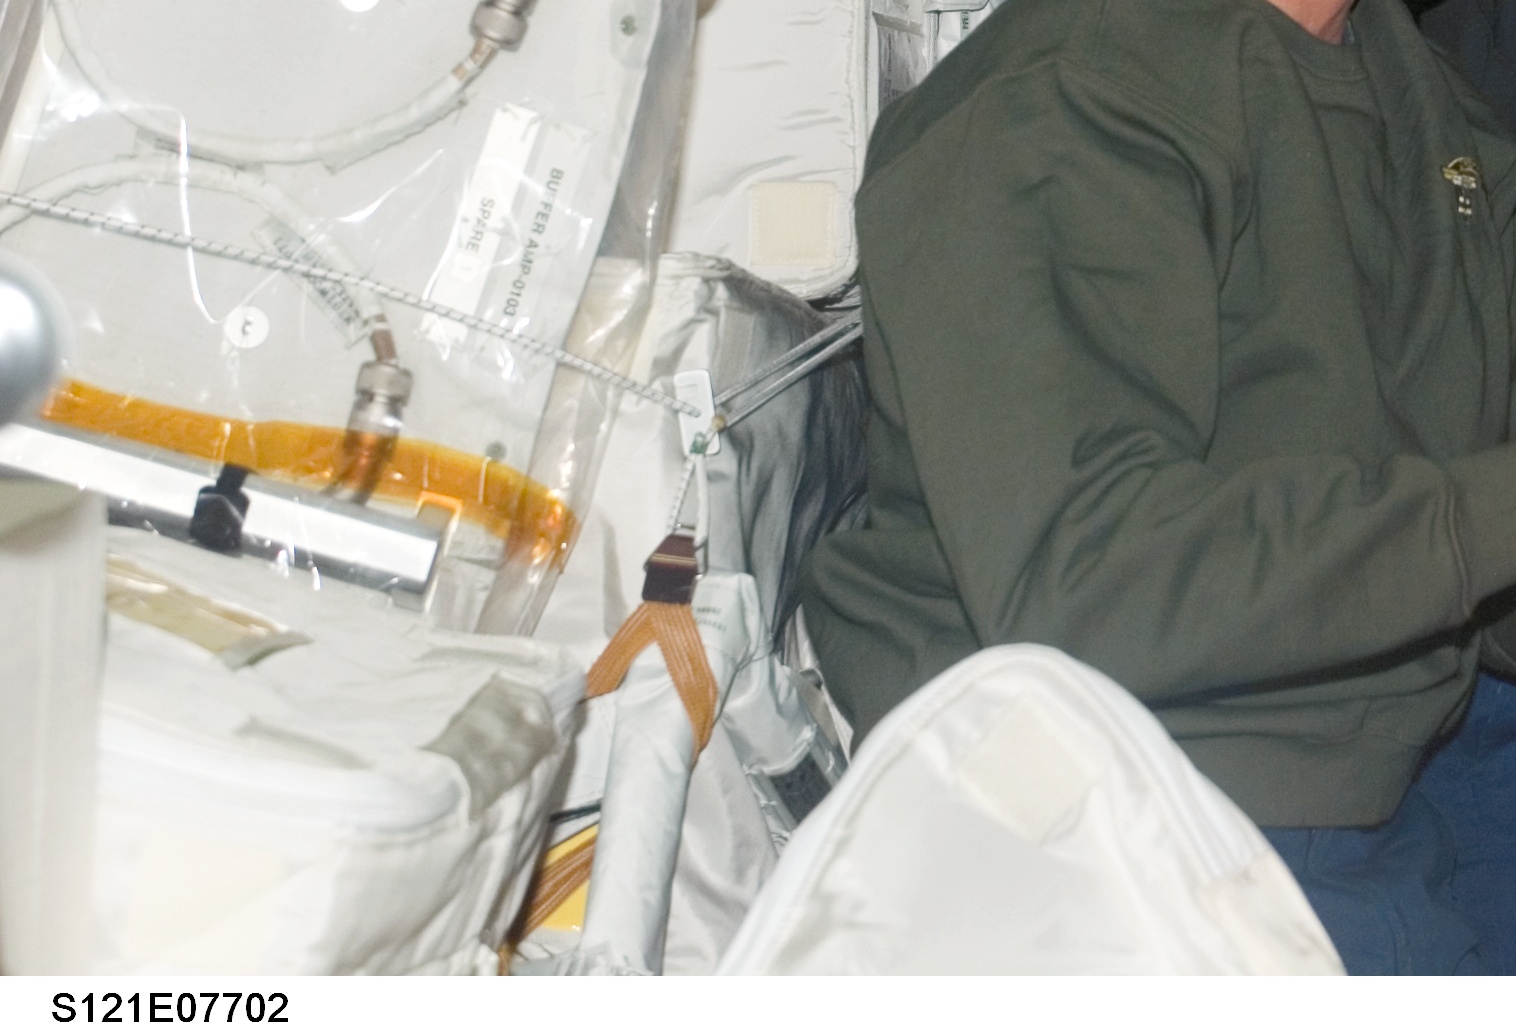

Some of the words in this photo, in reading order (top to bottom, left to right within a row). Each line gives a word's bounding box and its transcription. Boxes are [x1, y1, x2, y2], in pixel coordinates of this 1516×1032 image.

[465, 196, 496, 254] SPARE
[531, 167, 564, 235] BUFER
[503, 237, 540, 317] AMP-0103
